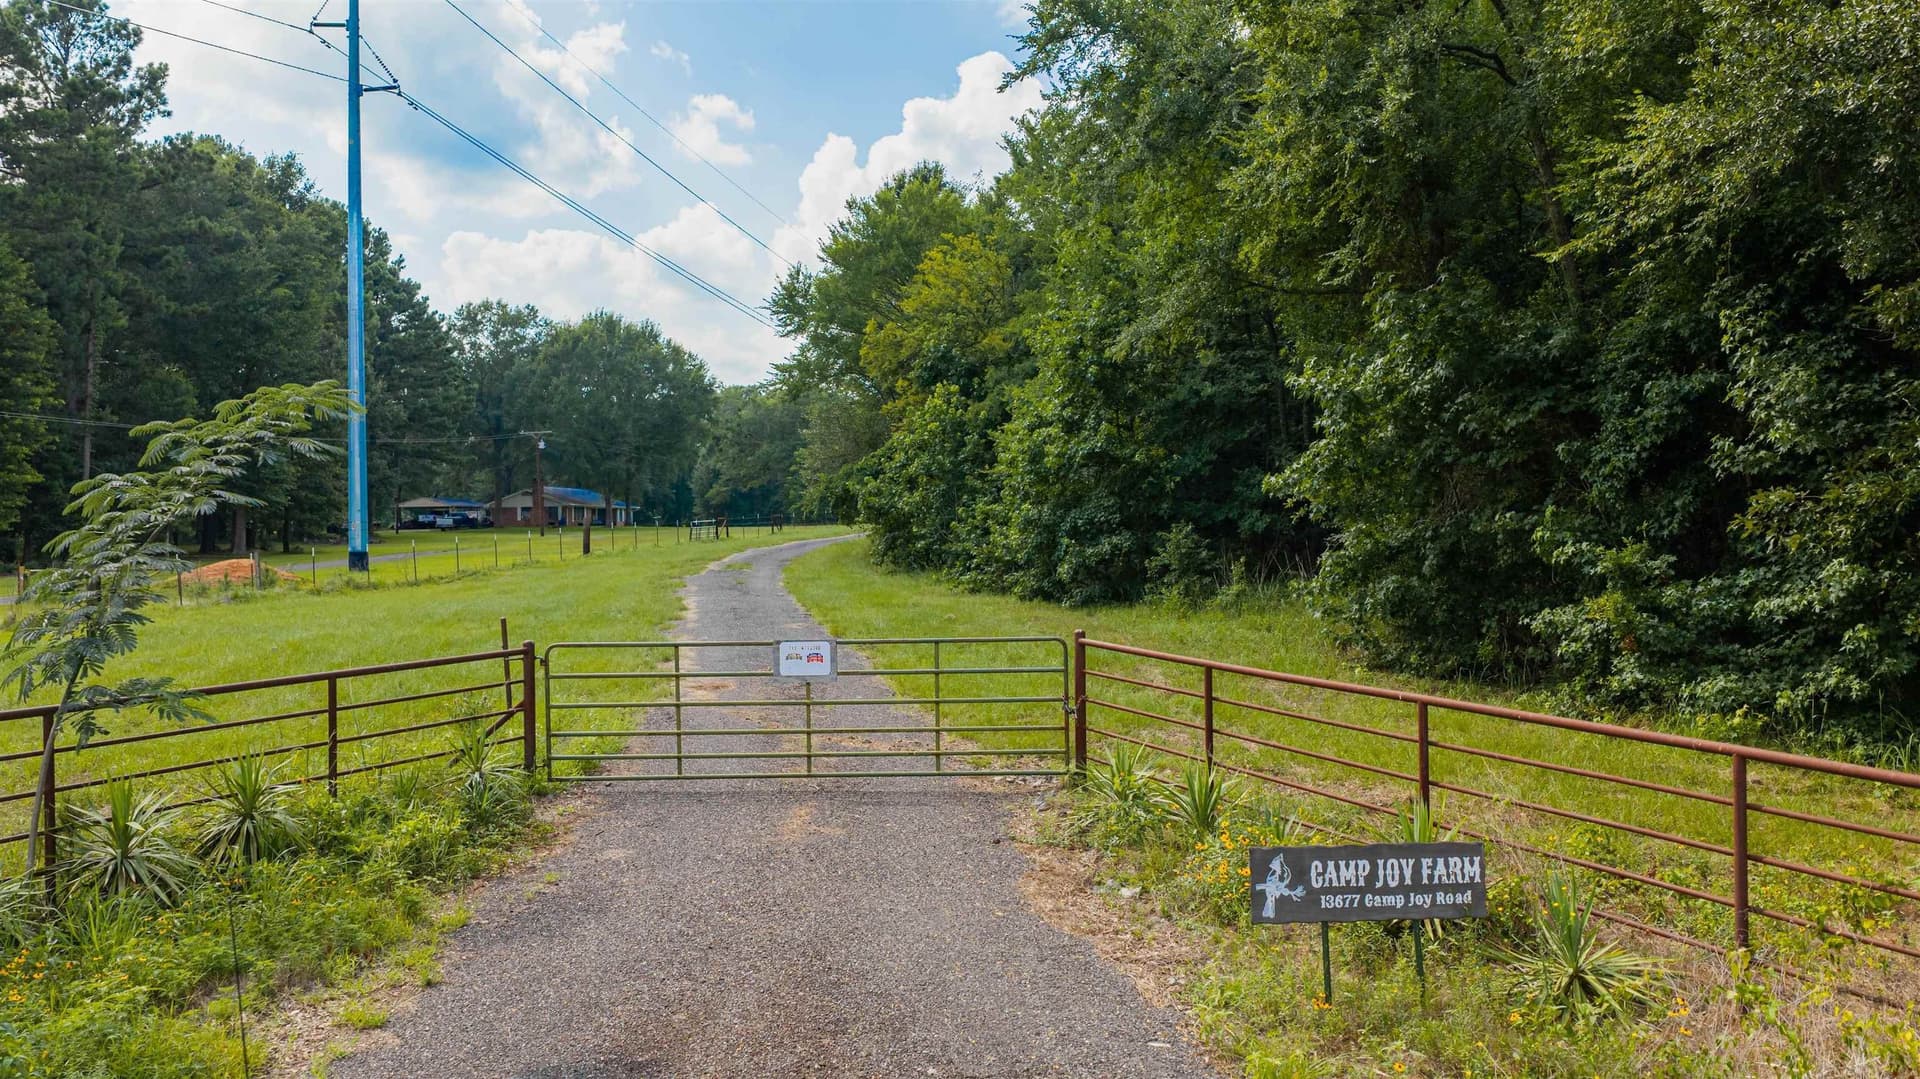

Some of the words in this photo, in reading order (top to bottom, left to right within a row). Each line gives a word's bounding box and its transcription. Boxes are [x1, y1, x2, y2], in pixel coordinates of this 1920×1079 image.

[1310, 859, 1370, 889] CAMP
[1375, 858, 1415, 889] JOY
[1420, 855, 1482, 885] FARM
[1320, 894, 1361, 909] 13677
[1365, 893, 1405, 909] Camp
[1408, 892, 1433, 908] Joy
[1436, 890, 1472, 905] Road
